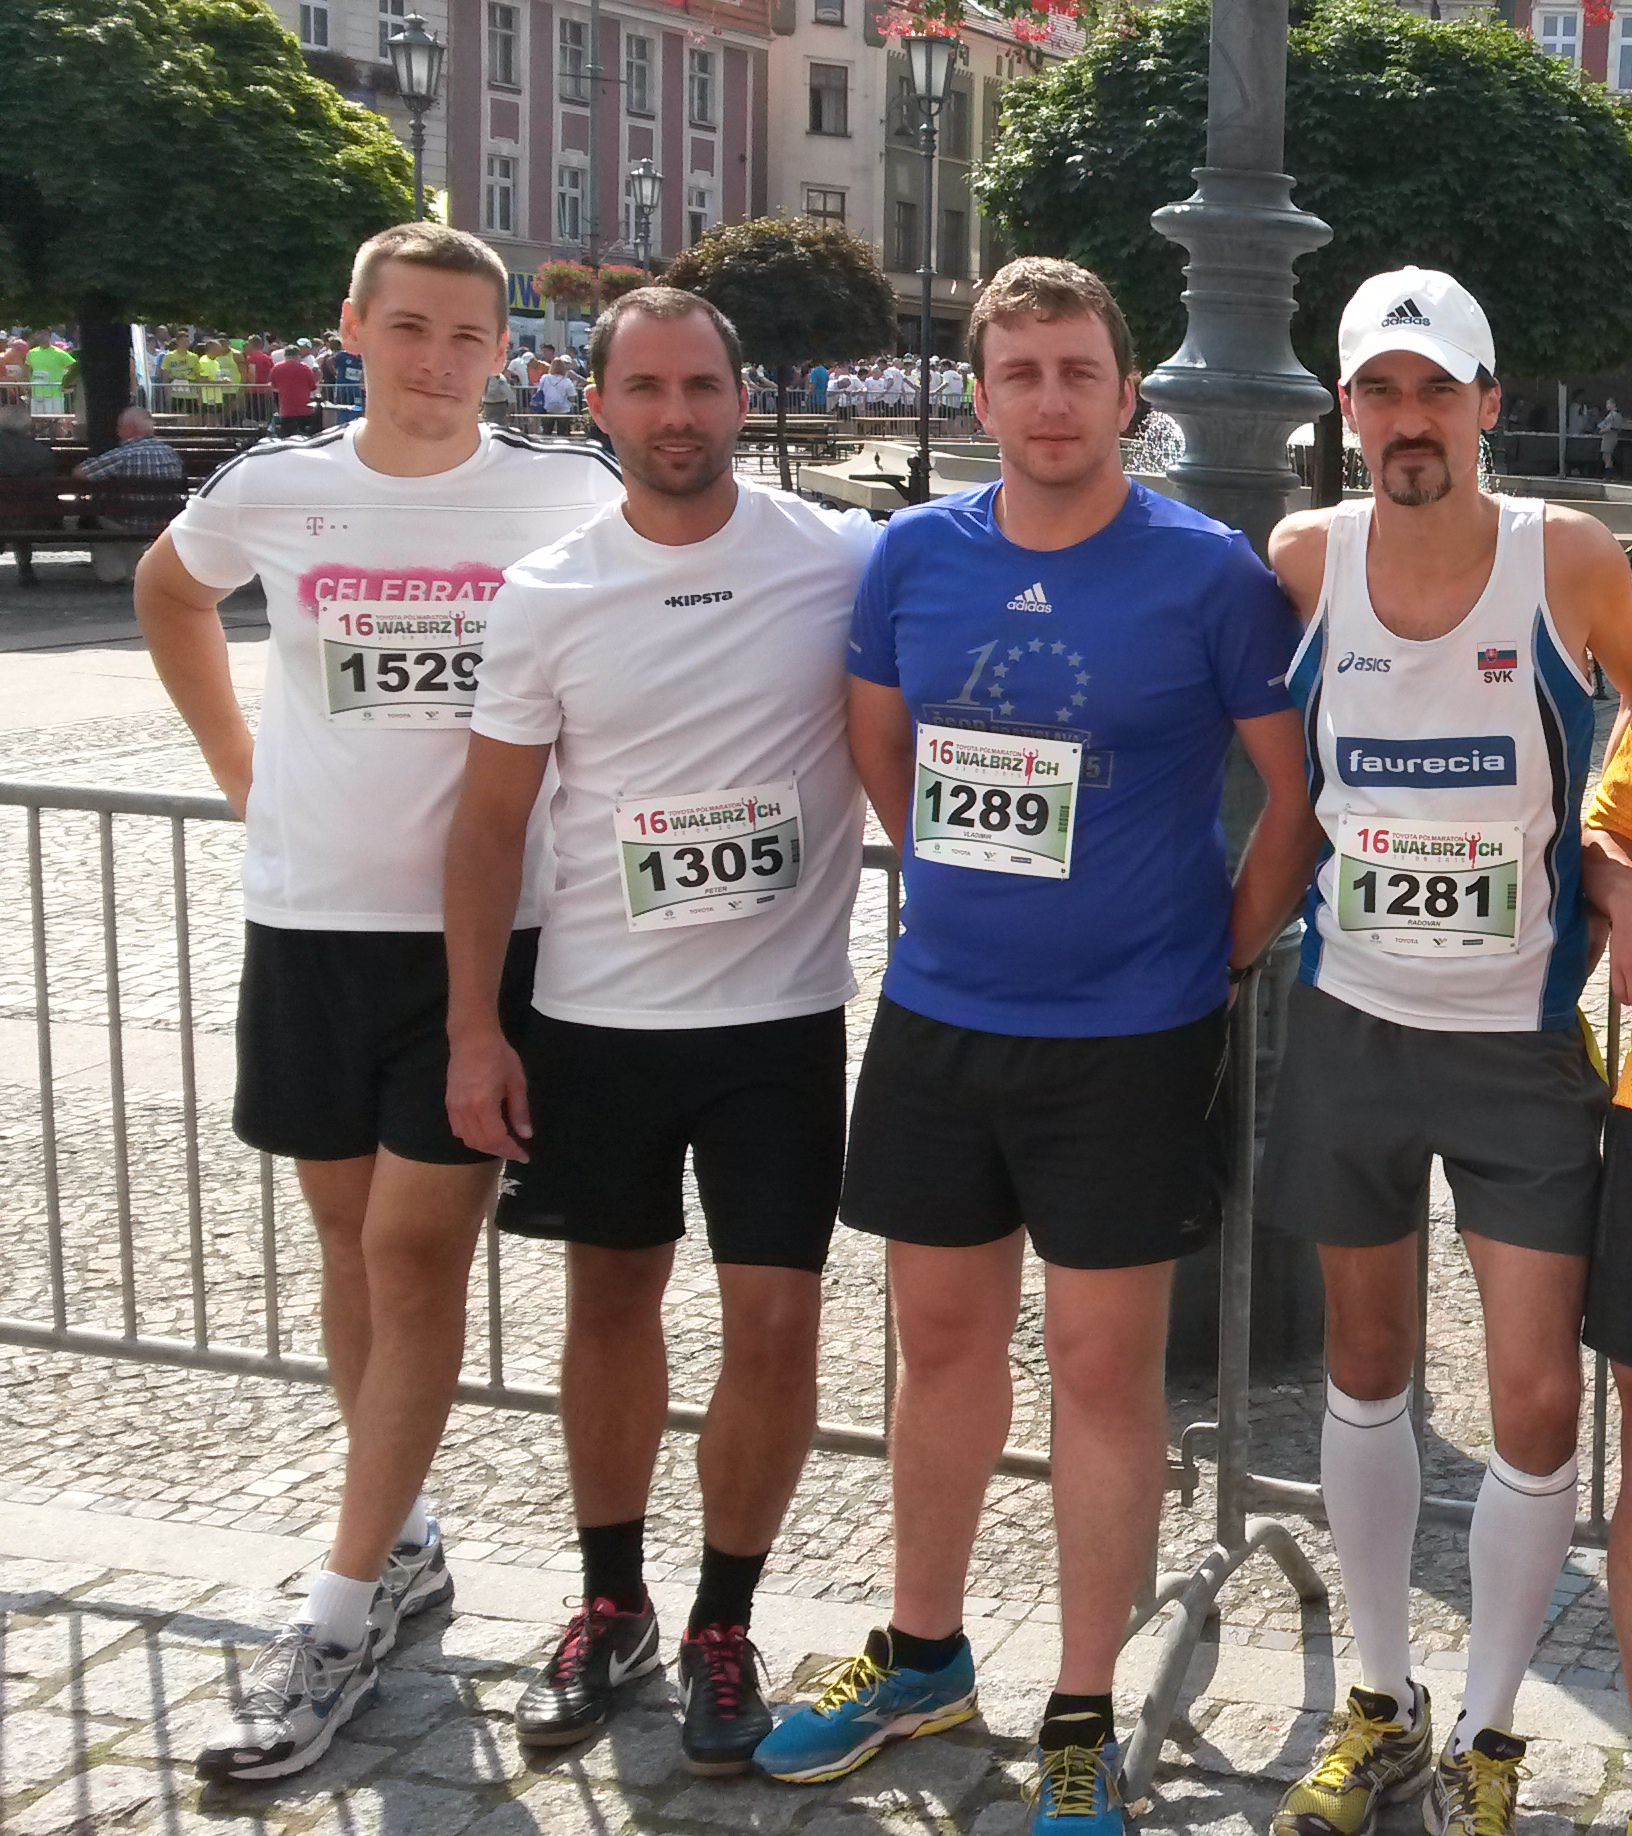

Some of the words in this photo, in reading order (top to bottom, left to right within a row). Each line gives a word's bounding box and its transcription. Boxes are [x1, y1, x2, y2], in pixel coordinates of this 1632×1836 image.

[1381, 316, 1431, 327] adidas
[1006, 599, 1053, 614] adidas
[338, 612, 374, 636] 16
[340, 651, 485, 693] 1529
[1354, 655, 1392, 673] asics
[1483, 670, 1514, 684] SVK
[929, 739, 954, 765] 16
[1348, 749, 1505, 774] faurecia
[925, 780, 1050, 837] 1289
[633, 810, 668, 836] 16
[1357, 828, 1390, 854] 16
[638, 834, 784, 892] 1305
[704, 885, 728, 894] PETER
[1352, 870, 1491, 918] 1281
[1407, 919, 1442, 927] RADOVAN
